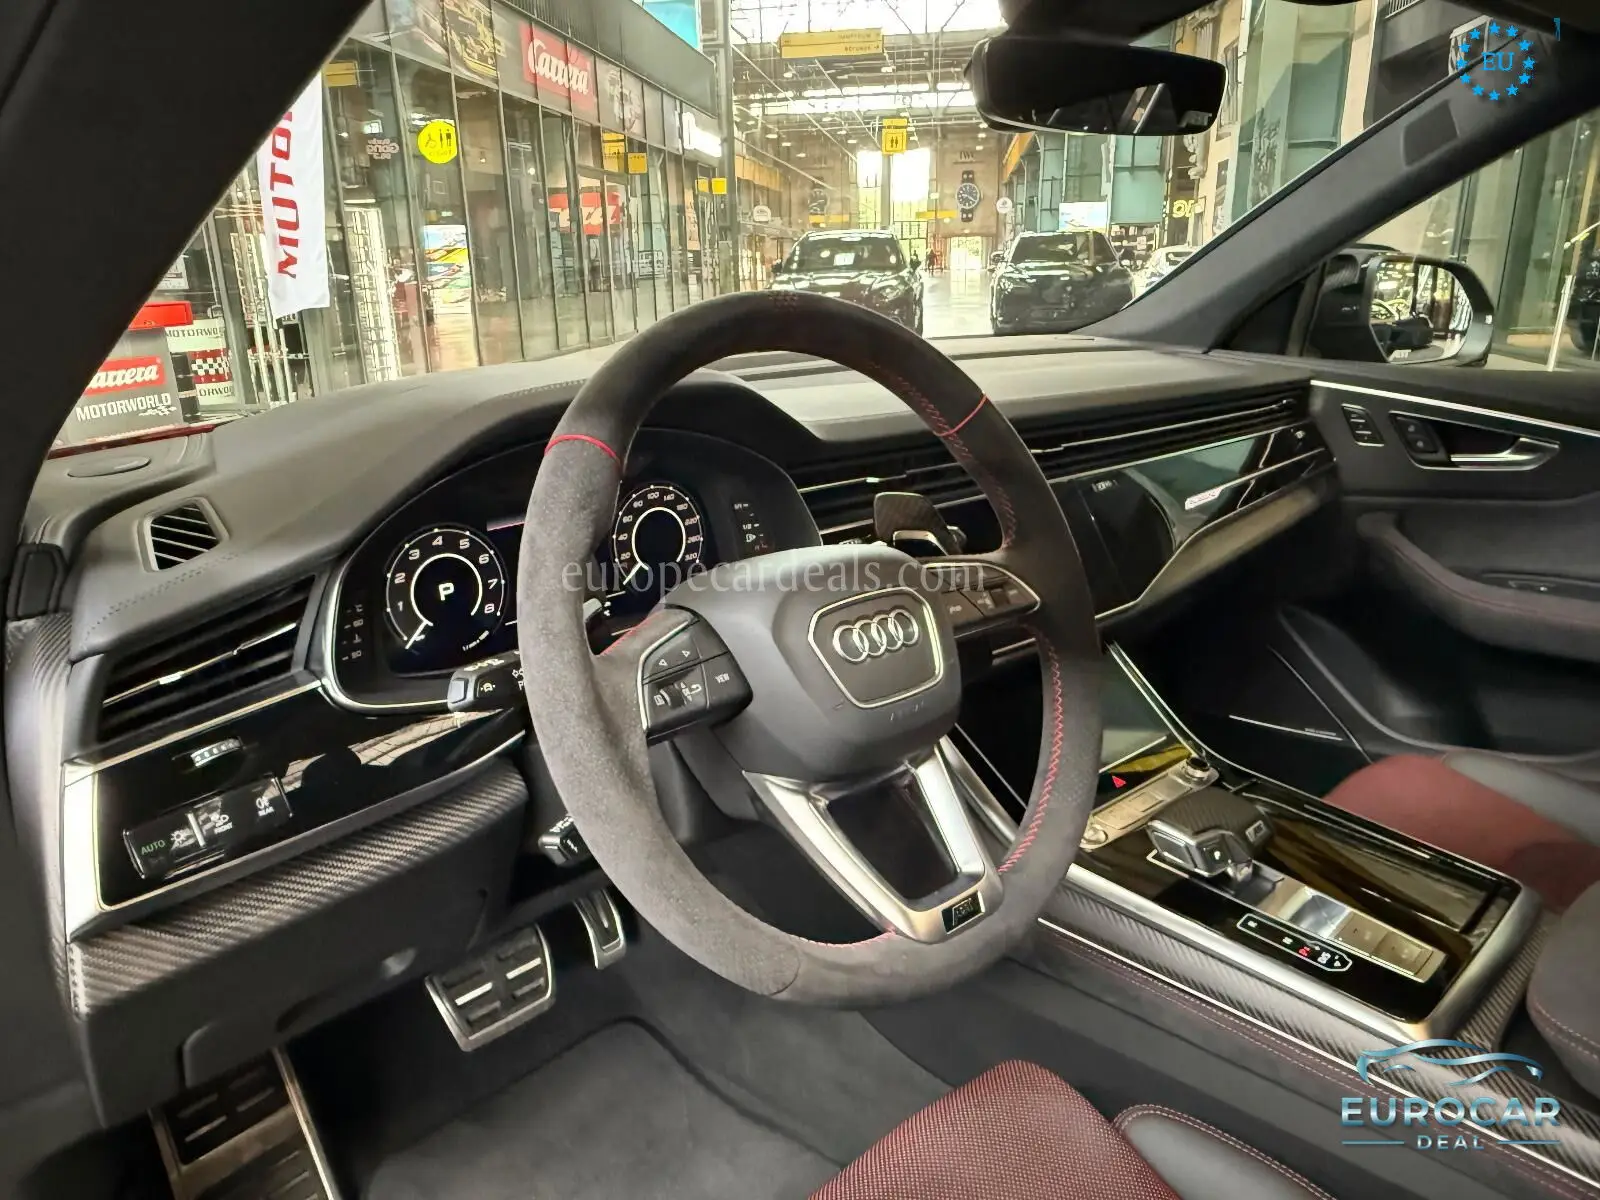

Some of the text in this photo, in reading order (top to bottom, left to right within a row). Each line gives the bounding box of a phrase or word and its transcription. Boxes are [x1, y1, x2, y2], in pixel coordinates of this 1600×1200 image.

[270, 112, 299, 279] MUTO
[86, 365, 160, 389] arrera
[76, 393, 171, 421] MOTORWORLD
[431, 536, 443, 546] 4
[459, 538, 470, 549] 5
[408, 549, 420, 560] 3
[479, 553, 490, 565] 6
[394, 572, 406, 584] 2
[488, 578, 498, 590] 7
[438, 582, 455, 601] P
[397, 600, 404, 611] 1
[484, 603, 495, 614] 8
[140, 839, 166, 855] AUTO
